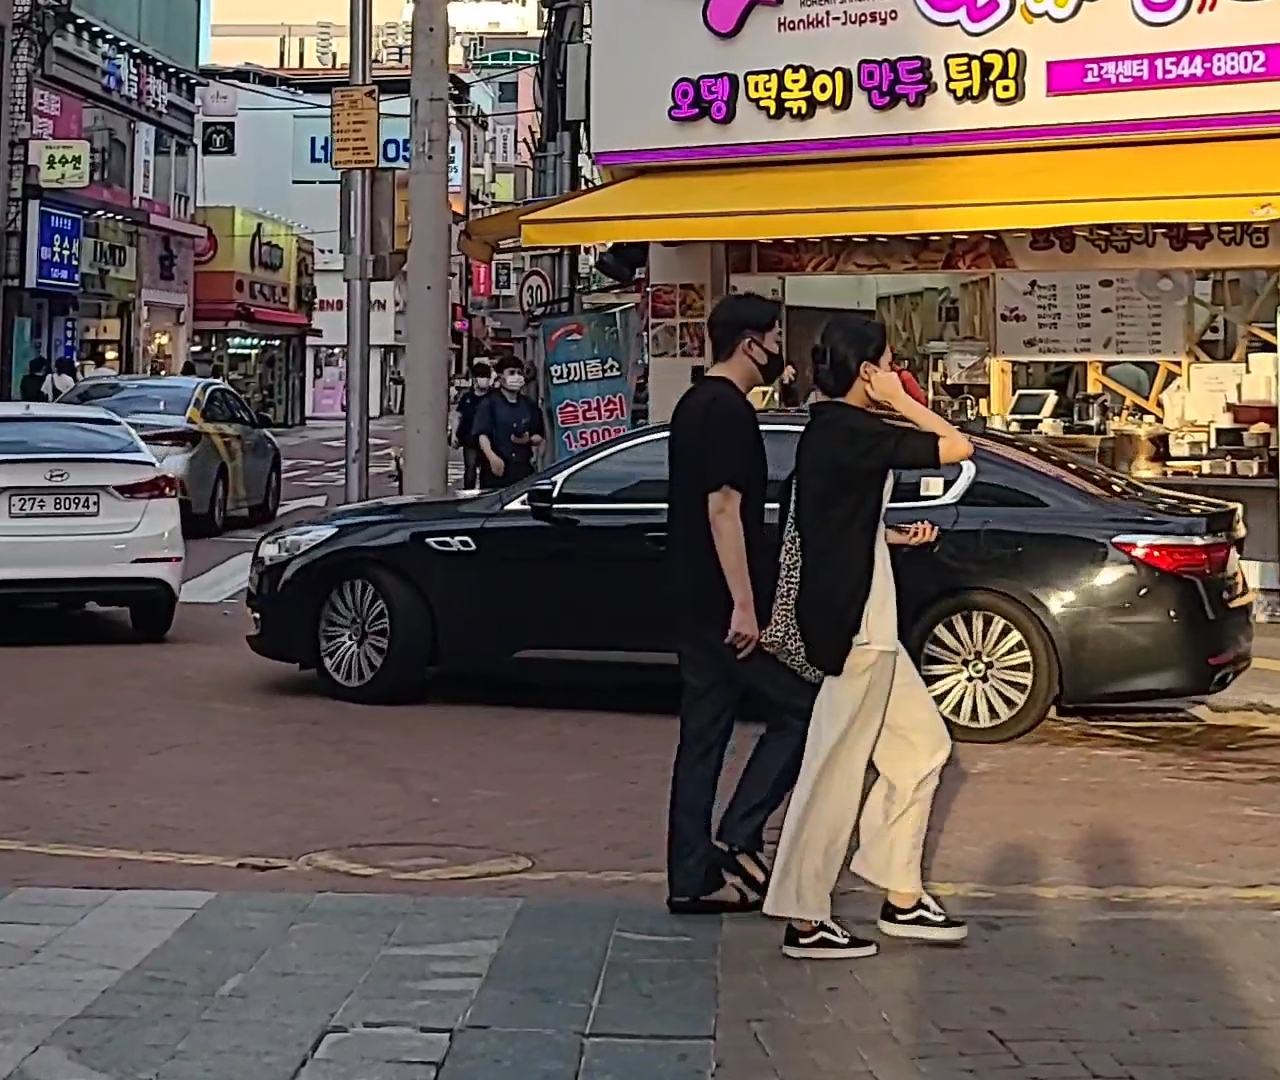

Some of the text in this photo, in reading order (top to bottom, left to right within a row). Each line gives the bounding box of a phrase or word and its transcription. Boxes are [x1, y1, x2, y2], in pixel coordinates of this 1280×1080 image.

[777, 9, 898, 33] Hankki-Jupsyo
[1082, 50, 1267, 85] 고객센터 1544-8802
[670, 51, 1020, 122] 오뎅 떡볶이 만두 튀김
[46, 153, 82, 170] 옷수선
[526, 283, 543, 307] 30
[557, 393, 627, 427] 슬러쉬
[18, 496, 91, 511] 27수 8094
